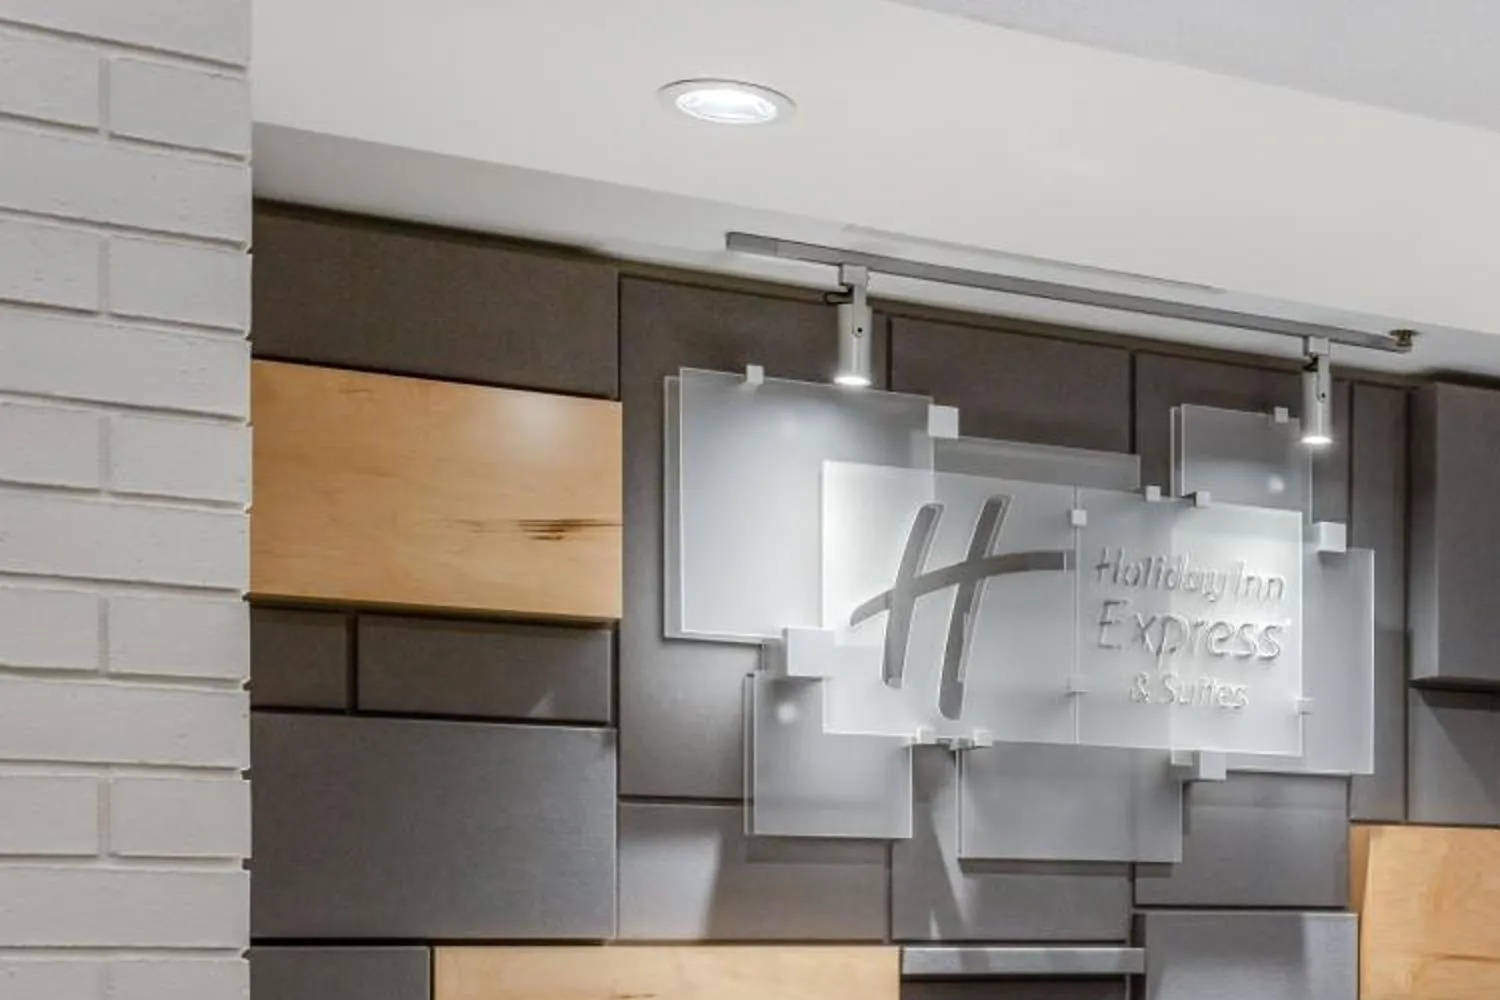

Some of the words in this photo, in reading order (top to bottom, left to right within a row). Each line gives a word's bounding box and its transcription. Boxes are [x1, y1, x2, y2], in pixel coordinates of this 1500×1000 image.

[1097, 599, 1281, 671] Express
[1128, 672, 1149, 704] &
[1160, 672, 1249, 710] Suites
